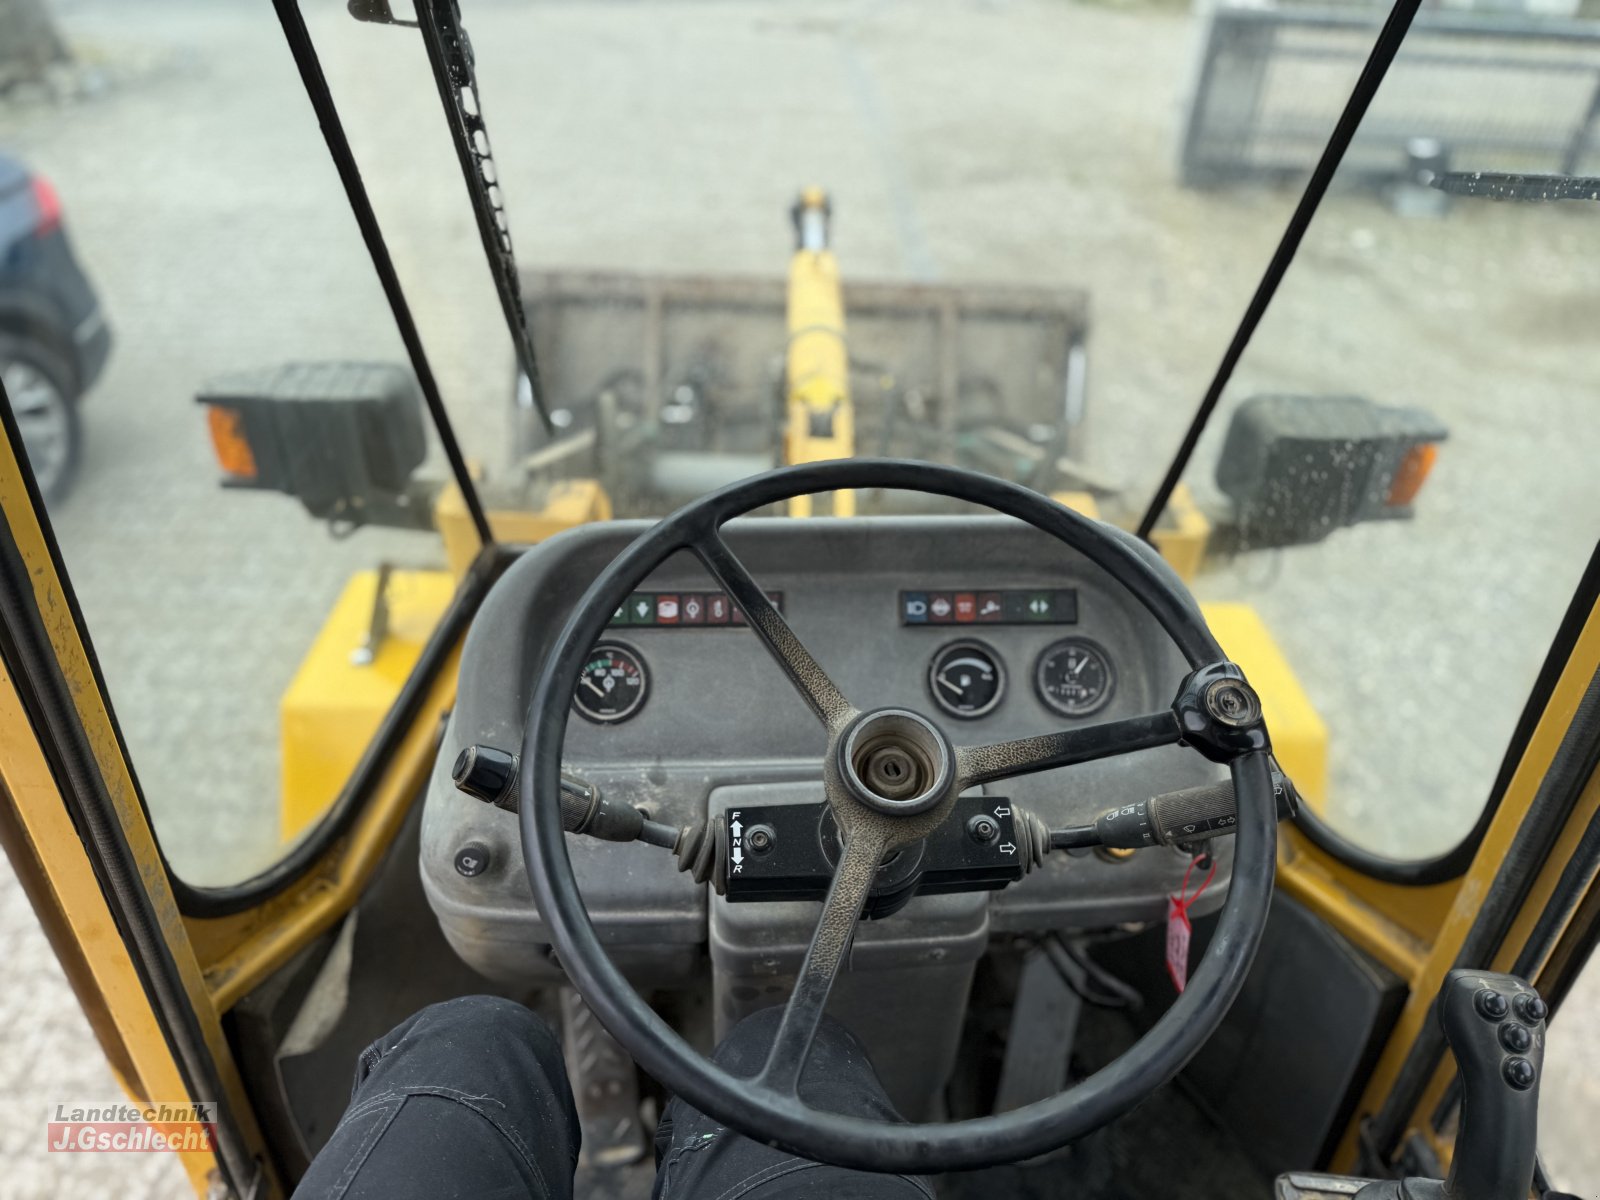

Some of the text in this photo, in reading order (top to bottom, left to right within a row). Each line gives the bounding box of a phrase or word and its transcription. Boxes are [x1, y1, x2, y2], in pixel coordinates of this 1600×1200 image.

[732, 811, 741, 820] F
[732, 838, 741, 847] N
[733, 864, 743, 873] R
